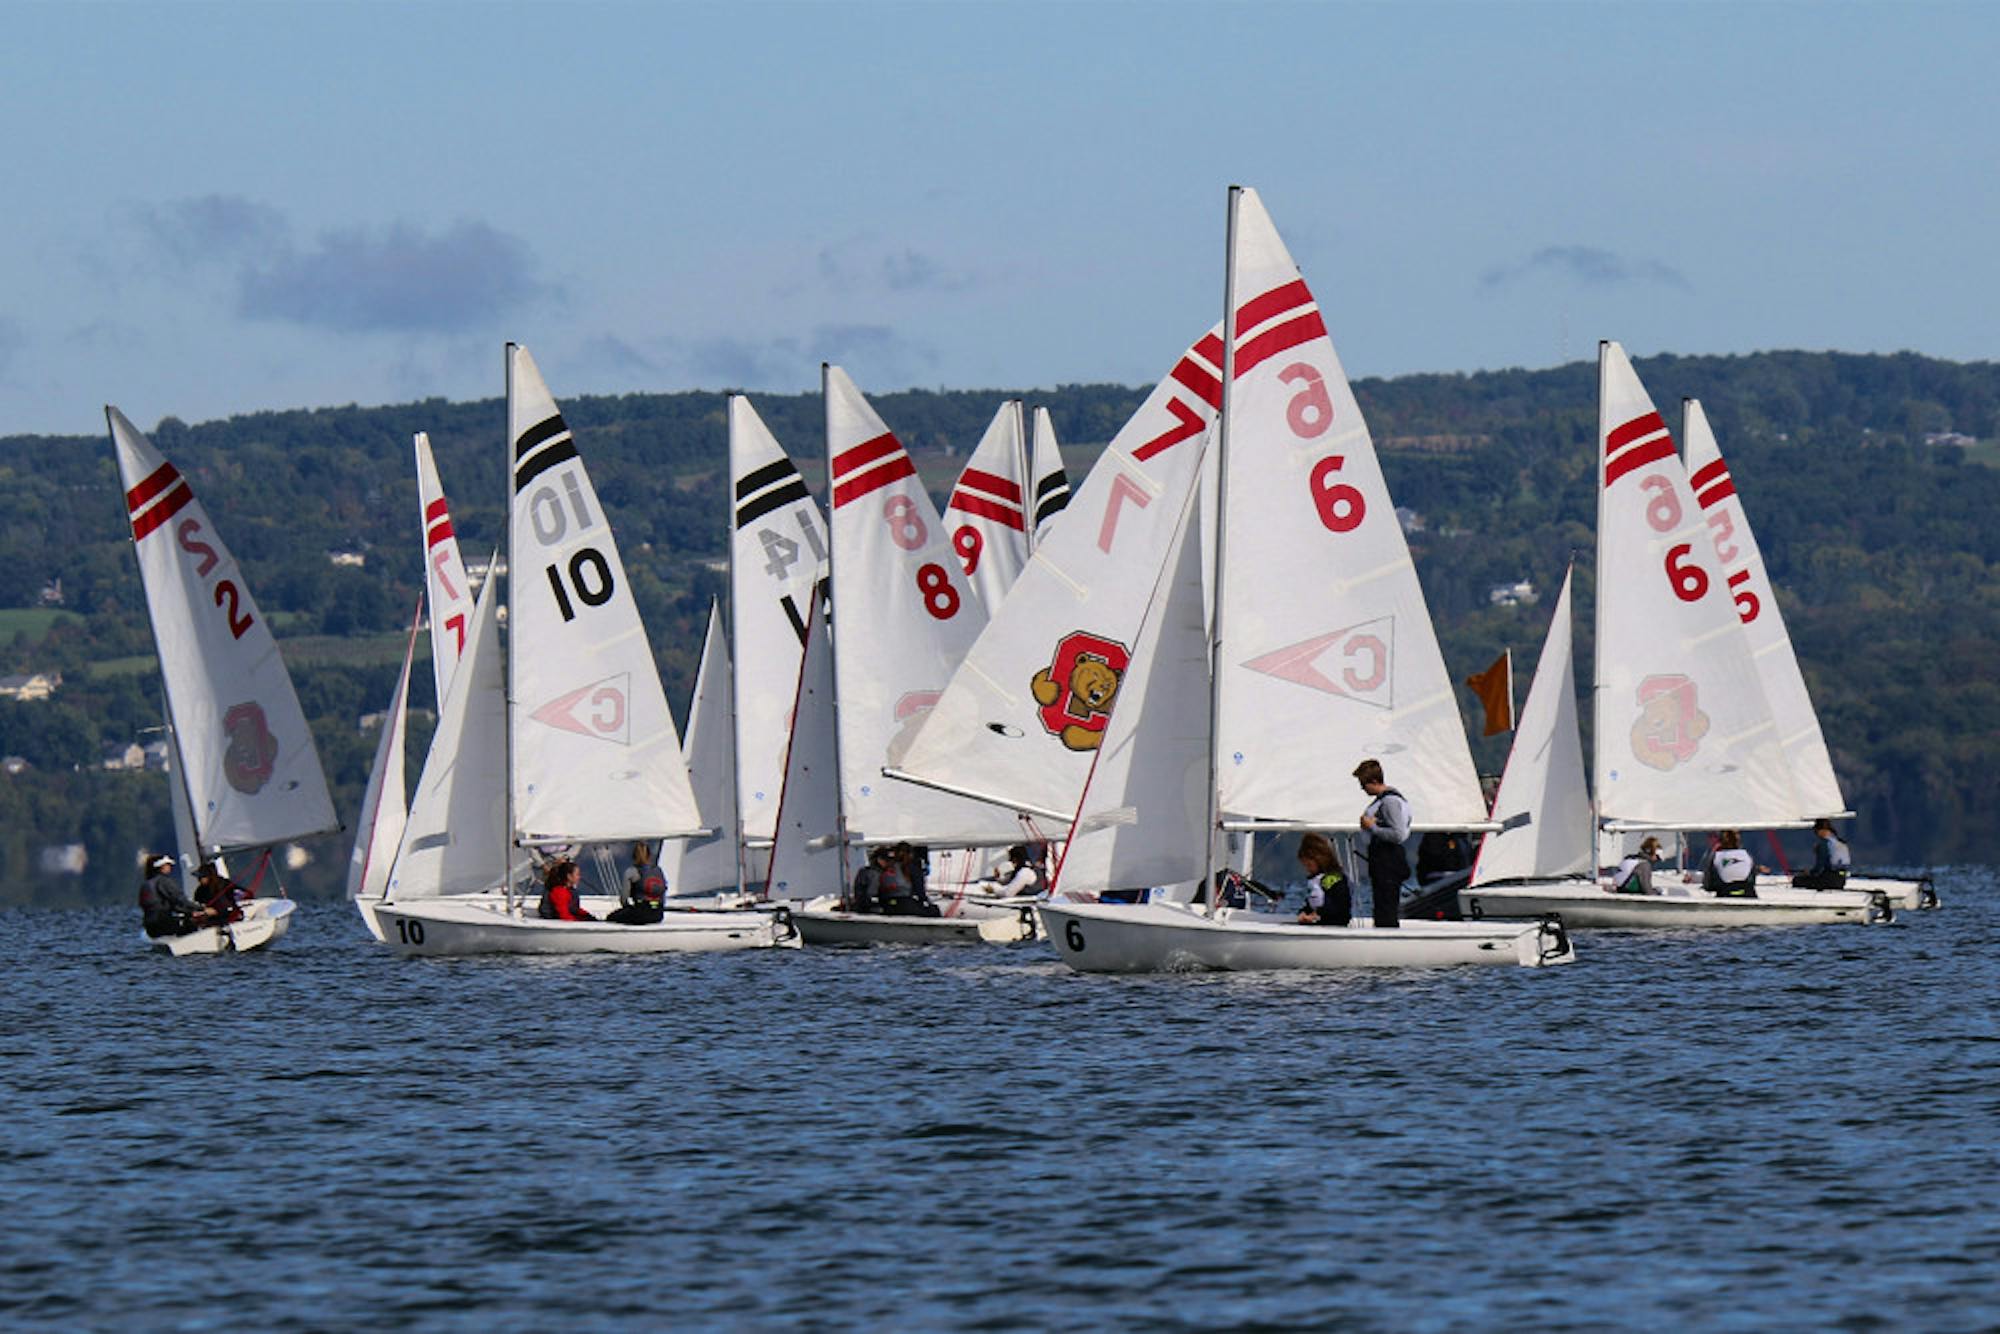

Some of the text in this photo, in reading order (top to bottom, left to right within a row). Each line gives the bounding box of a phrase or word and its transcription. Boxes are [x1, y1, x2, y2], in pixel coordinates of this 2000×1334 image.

[1130, 396, 1205, 462] 7
[1310, 455, 1366, 533] 6
[884, 495, 928, 551] 8
[952, 525, 983, 576] 9
[546, 548, 614, 622] 10
[916, 563, 960, 620] 8
[1665, 543, 1708, 602] 6
[1728, 569, 1760, 624] 5
[215, 580, 254, 640] 2
[396, 920, 424, 944] 10
[1066, 920, 1085, 952] 6
